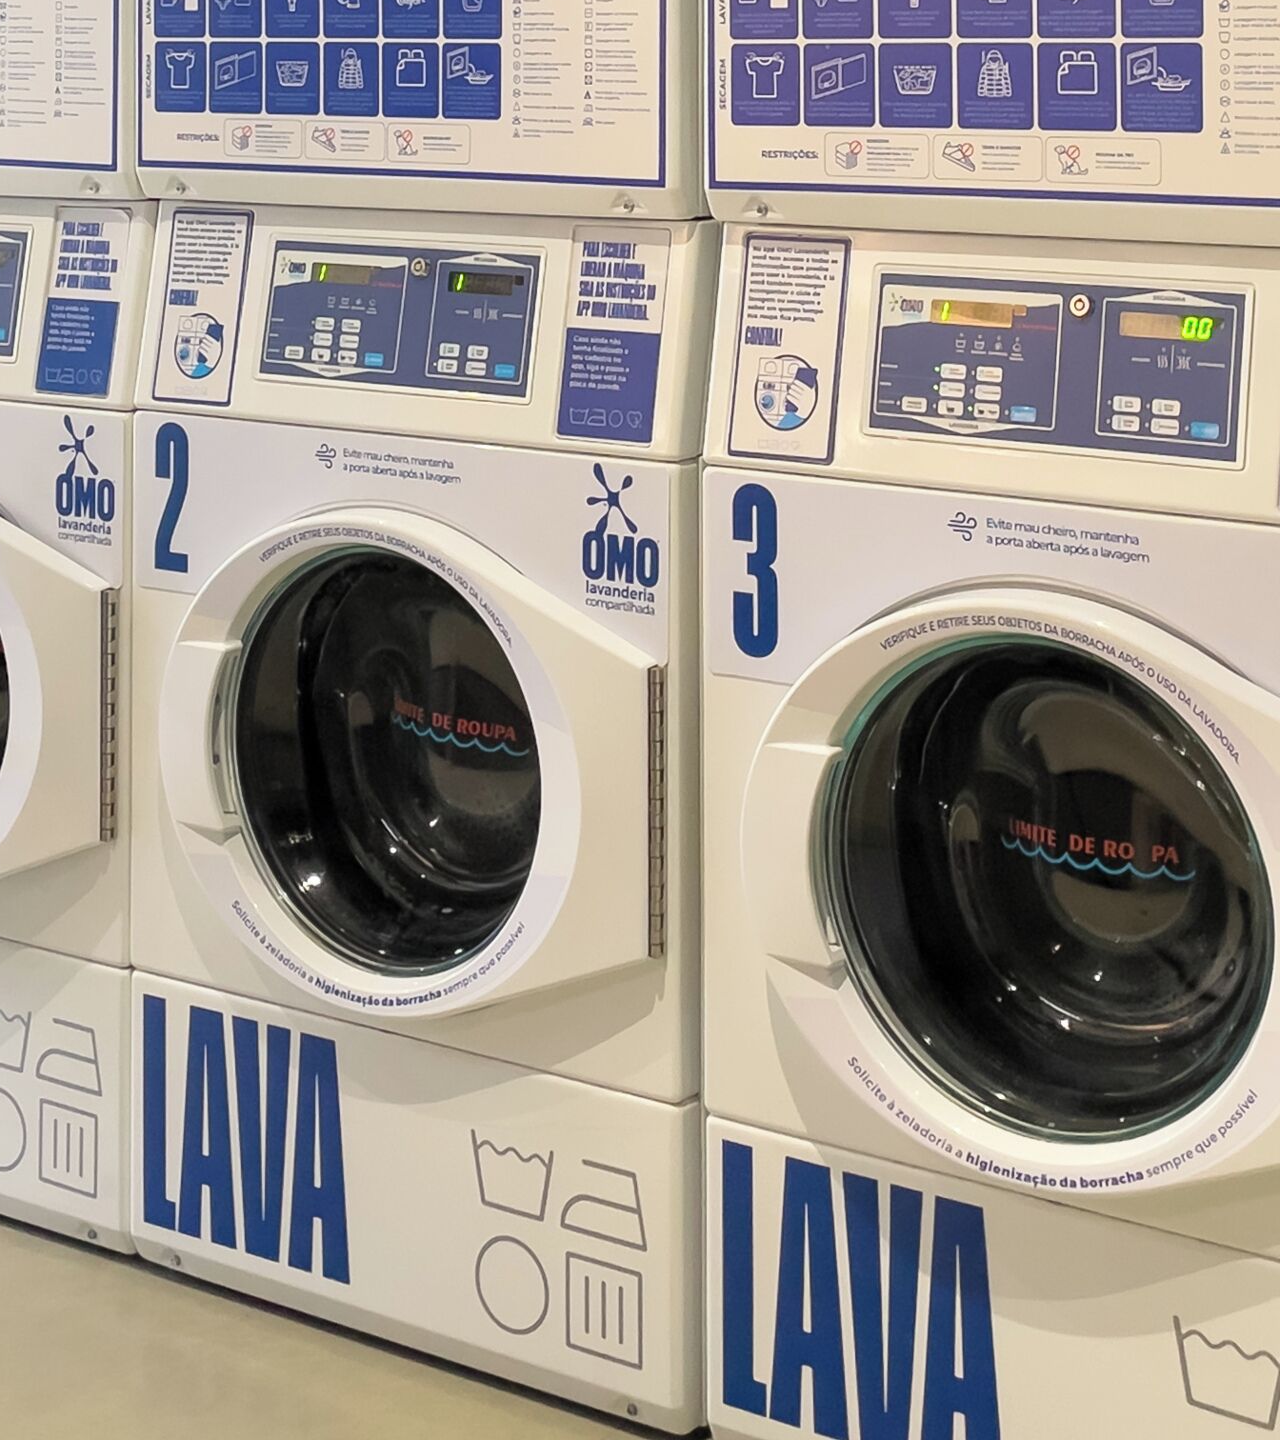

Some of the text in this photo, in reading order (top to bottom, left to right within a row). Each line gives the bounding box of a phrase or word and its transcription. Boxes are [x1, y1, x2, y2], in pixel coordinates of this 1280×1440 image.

[1182, 317, 1213, 339] 00
[56, 473, 114, 522] OMO
[155, 422, 189, 574] 2
[58, 517, 111, 534] lavanderia
[987, 518, 1139, 545] Evite mau cheiro, mantenha
[987, 536, 1149, 563] a porta aberta após a lavagem
[583, 531, 659, 587] OMO
[731, 483, 779, 658] 3
[586, 580, 654, 602] lavanderia
[586, 598, 655, 615] compartilhada
[880, 623, 927, 650] VERIFIQUE
[930, 621, 935, 631] E
[937, 615, 969, 629] RETIRE
[972, 615, 995, 625] SEUS
[998, 616, 1042, 631] OBJETOS
[1044, 624, 1058, 635] DA
[1061, 628, 1116, 657] BORRACHA
[1118, 651, 1145, 672] APÓS
[1147, 667, 1155, 677] O
[1157, 673, 1177, 694] USO
[1178, 689, 1192, 707] DA
[432, 713, 516, 742] DE ROUPA
[1009, 818, 1179, 864] LIMITE DE ROPA
[232, 900, 260, 938] Solicite
[265, 941, 306, 979] zeladoria
[315, 977, 380, 1007] higienização
[382, 997, 394, 1006] da
[396, 990, 441, 1006] borracha
[443, 972, 477, 995] sempre
[479, 958, 496, 975] que
[143, 994, 350, 1285] LAVA
[848, 1057, 887, 1102] Solicite
[896, 1108, 953, 1154] zeladoria
[955, 1150, 963, 1158] a
[966, 1152, 1056, 1188] higienização
[1060, 1176, 1077, 1189] da
[1080, 1169, 1144, 1189] borracha
[1146, 1150, 1193, 1178] sempre
[1195, 1135, 1218, 1154] que
[1218, 1089, 1258, 1138] possível
[721, 1137, 1003, 1440] LAVA
